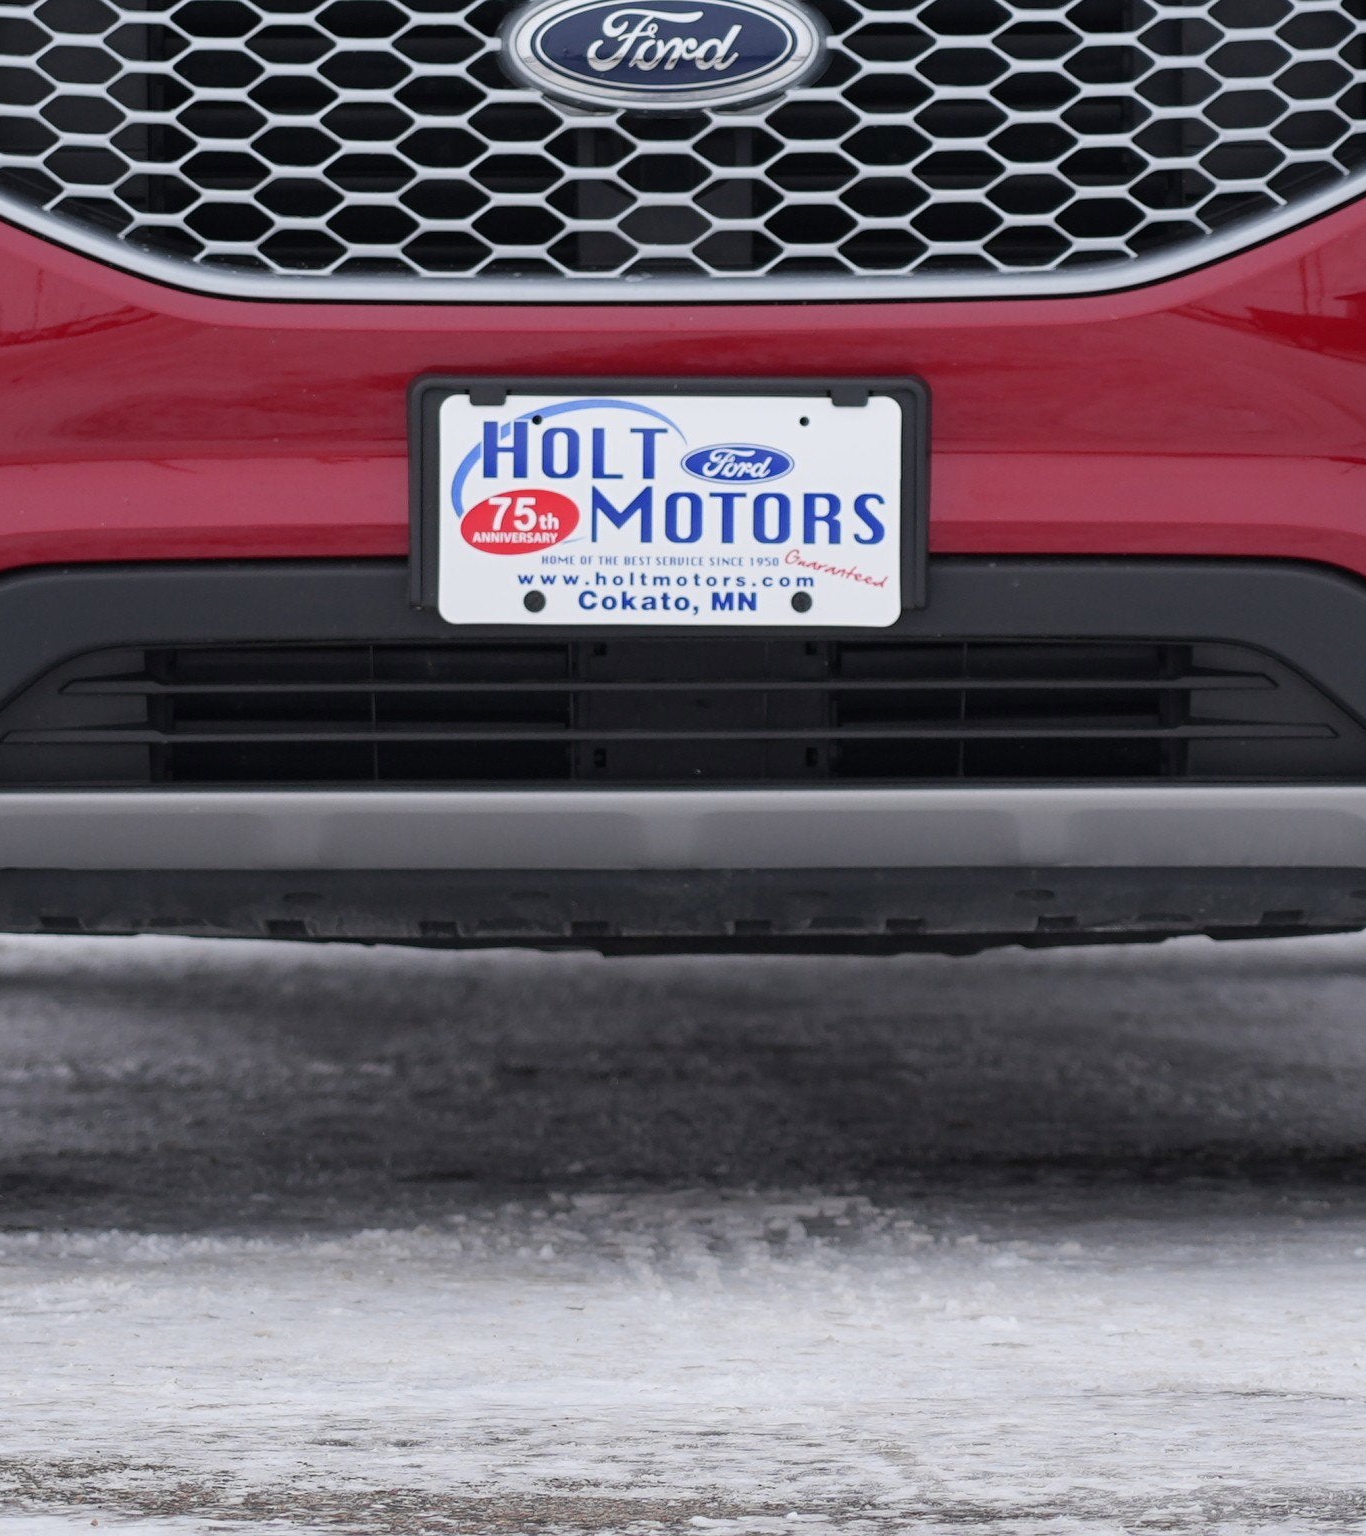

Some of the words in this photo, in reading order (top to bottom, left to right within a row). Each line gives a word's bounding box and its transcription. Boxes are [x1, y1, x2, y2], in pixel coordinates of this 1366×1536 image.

[586, 8, 743, 72] Ford
[482, 420, 669, 480] HOLT
[702, 447, 773, 481] Ford
[488, 496, 560, 531] 75th
[590, 485, 886, 545] MOTORS
[472, 531, 559, 544] ANNIVERSARY
[541, 555, 576, 565] HOME
[580, 555, 594, 565] OF
[599, 555, 617, 565] THE
[624, 555, 651, 565] BEST
[656, 556, 704, 566] SERVICE
[709, 556, 744, 567] SINCE
[750, 556, 780, 567] 1950
[784, 548, 890, 589] Guaranteed
[518, 571, 814, 587] www.holtmotors.com
[578, 590, 699, 615] Cokato,
[711, 591, 757, 611] MN
